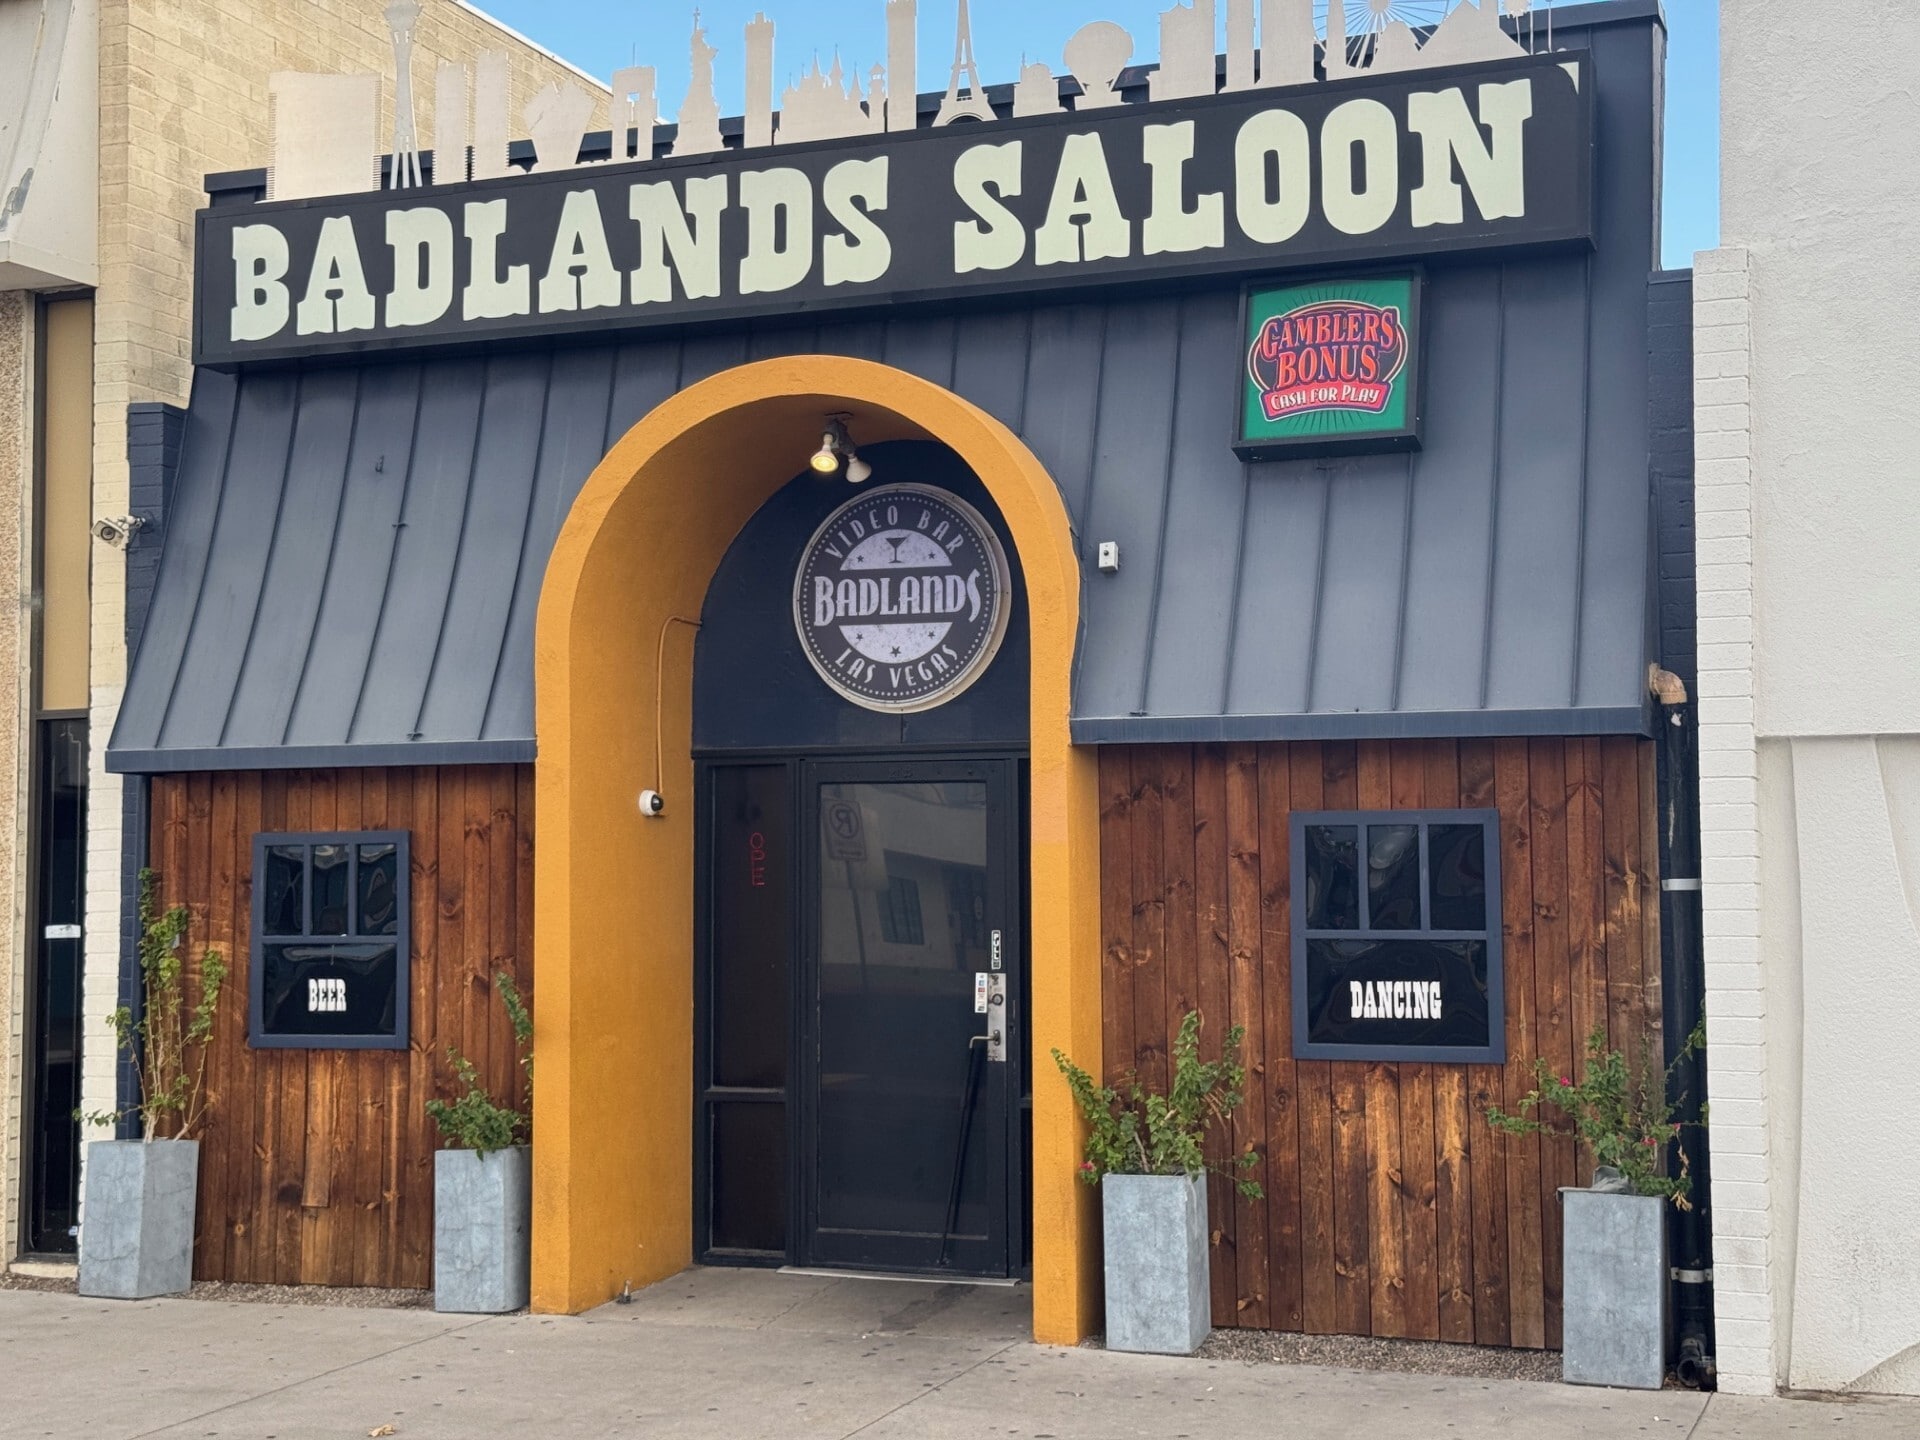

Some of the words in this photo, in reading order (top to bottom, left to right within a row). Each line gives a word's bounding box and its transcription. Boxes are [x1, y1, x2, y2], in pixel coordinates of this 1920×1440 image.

[230, 156, 890, 341] BADLANDS
[953, 78, 1532, 273] SALOON
[1263, 313, 1393, 358] GAMBLERS
[1278, 346, 1377, 389] BONUS
[1271, 391, 1306, 410] CASH
[1340, 384, 1380, 403] PLAY
[825, 505, 898, 559] VIDEO
[917, 509, 964, 554] BAR
[814, 568, 981, 627] BADLANDS
[835, 648, 876, 683] LAS
[889, 644, 958, 688] VEGAS
[308, 978, 347, 1012] BEER
[1350, 980, 1442, 1019] DANCING
